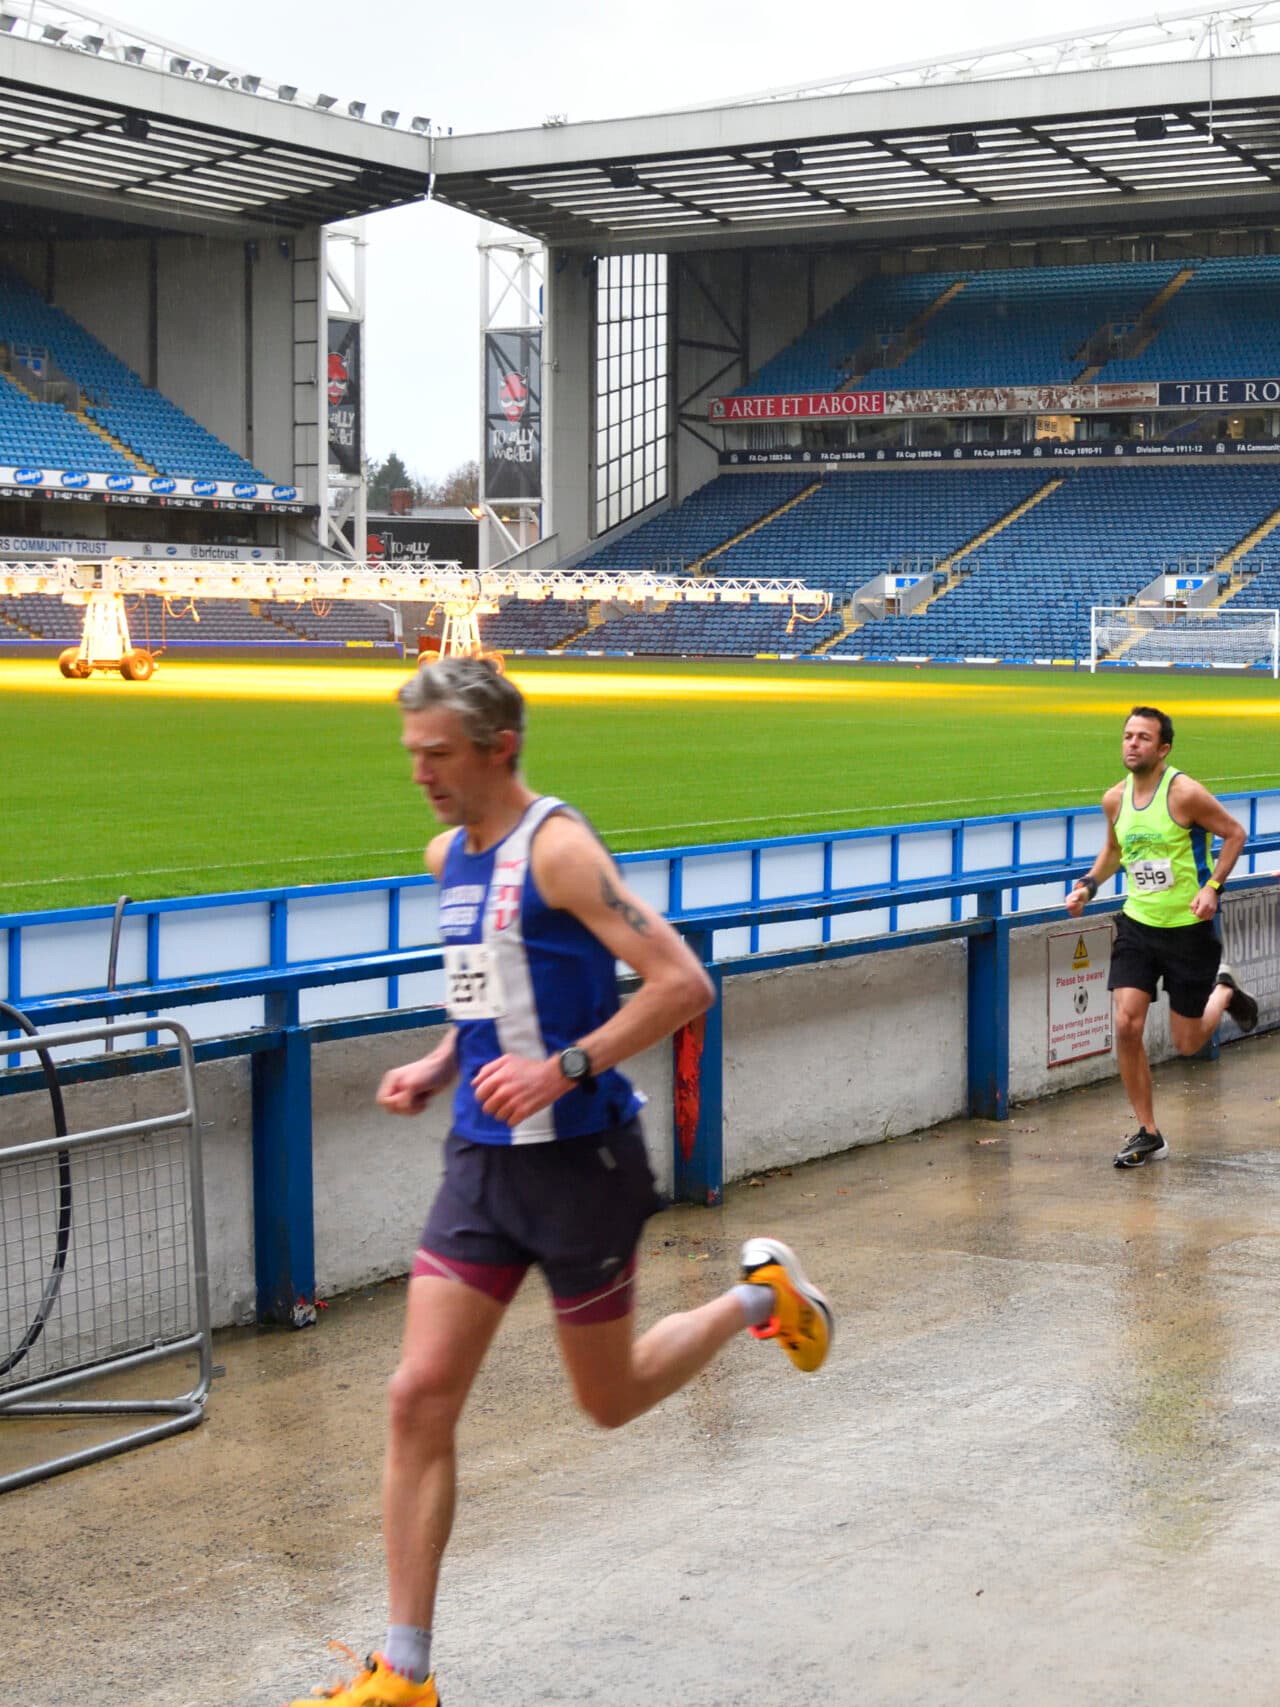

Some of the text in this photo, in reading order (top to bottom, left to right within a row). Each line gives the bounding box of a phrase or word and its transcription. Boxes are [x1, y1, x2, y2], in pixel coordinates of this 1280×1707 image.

[1176, 383, 1229, 404] THE
[730, 394, 880, 417] ARTE ET LABORE
[1176, 445, 1203, 453] 1911-12
[14, 540, 73, 553] COMMUNITY
[76, 541, 107, 554] TRUST
[190, 546, 239, 559] @brfctrust
[1135, 871, 1166, 885] 549
[1056, 976, 1076, 988] Please
[1065, 1019, 1083, 1030] entering
[1084, 1016, 1093, 1024] this
[1052, 1033, 1065, 1043] speed
[1066, 1032, 1076, 1040] may
[1072, 1040, 1090, 1050] persons
